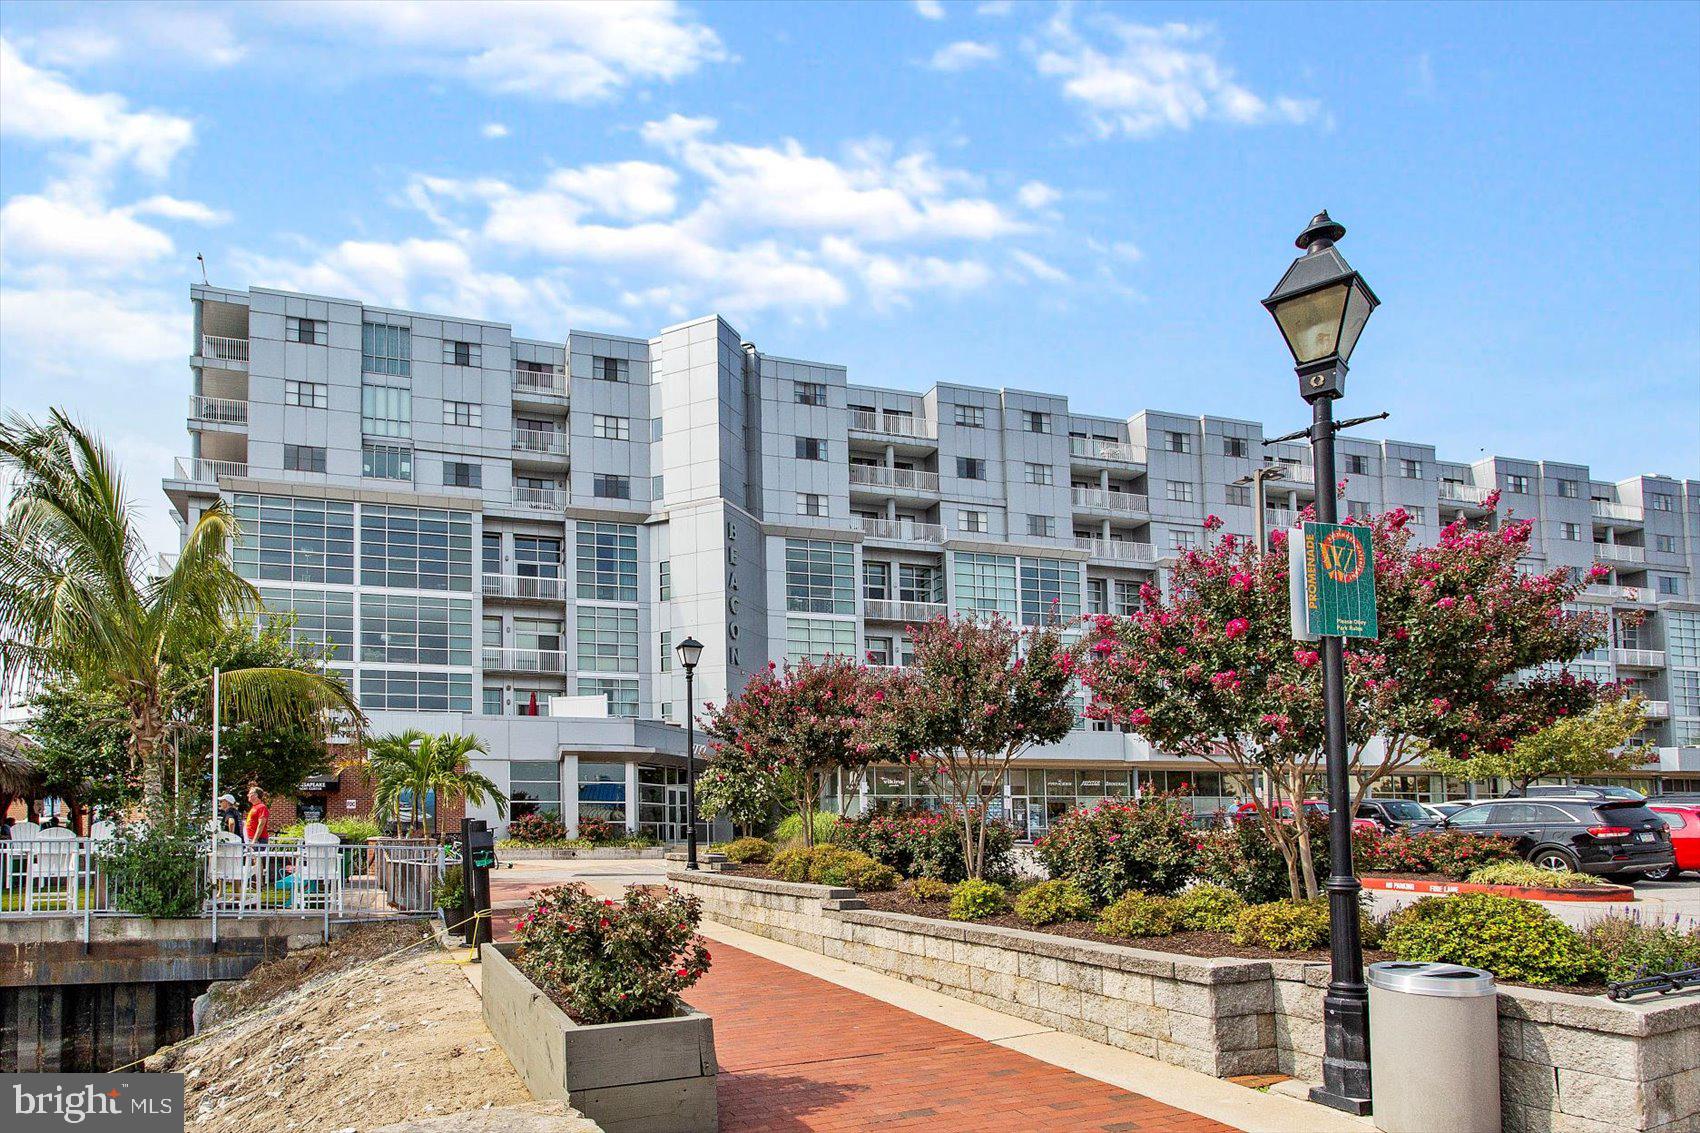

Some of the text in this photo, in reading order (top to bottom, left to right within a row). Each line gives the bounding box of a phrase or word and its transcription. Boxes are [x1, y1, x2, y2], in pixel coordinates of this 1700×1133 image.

[727, 521, 742, 666] BEACON
[1306, 534, 1318, 609] PROMENADE
[1393, 882, 1415, 891] PARKING
[1429, 885, 1442, 893] FIRE
